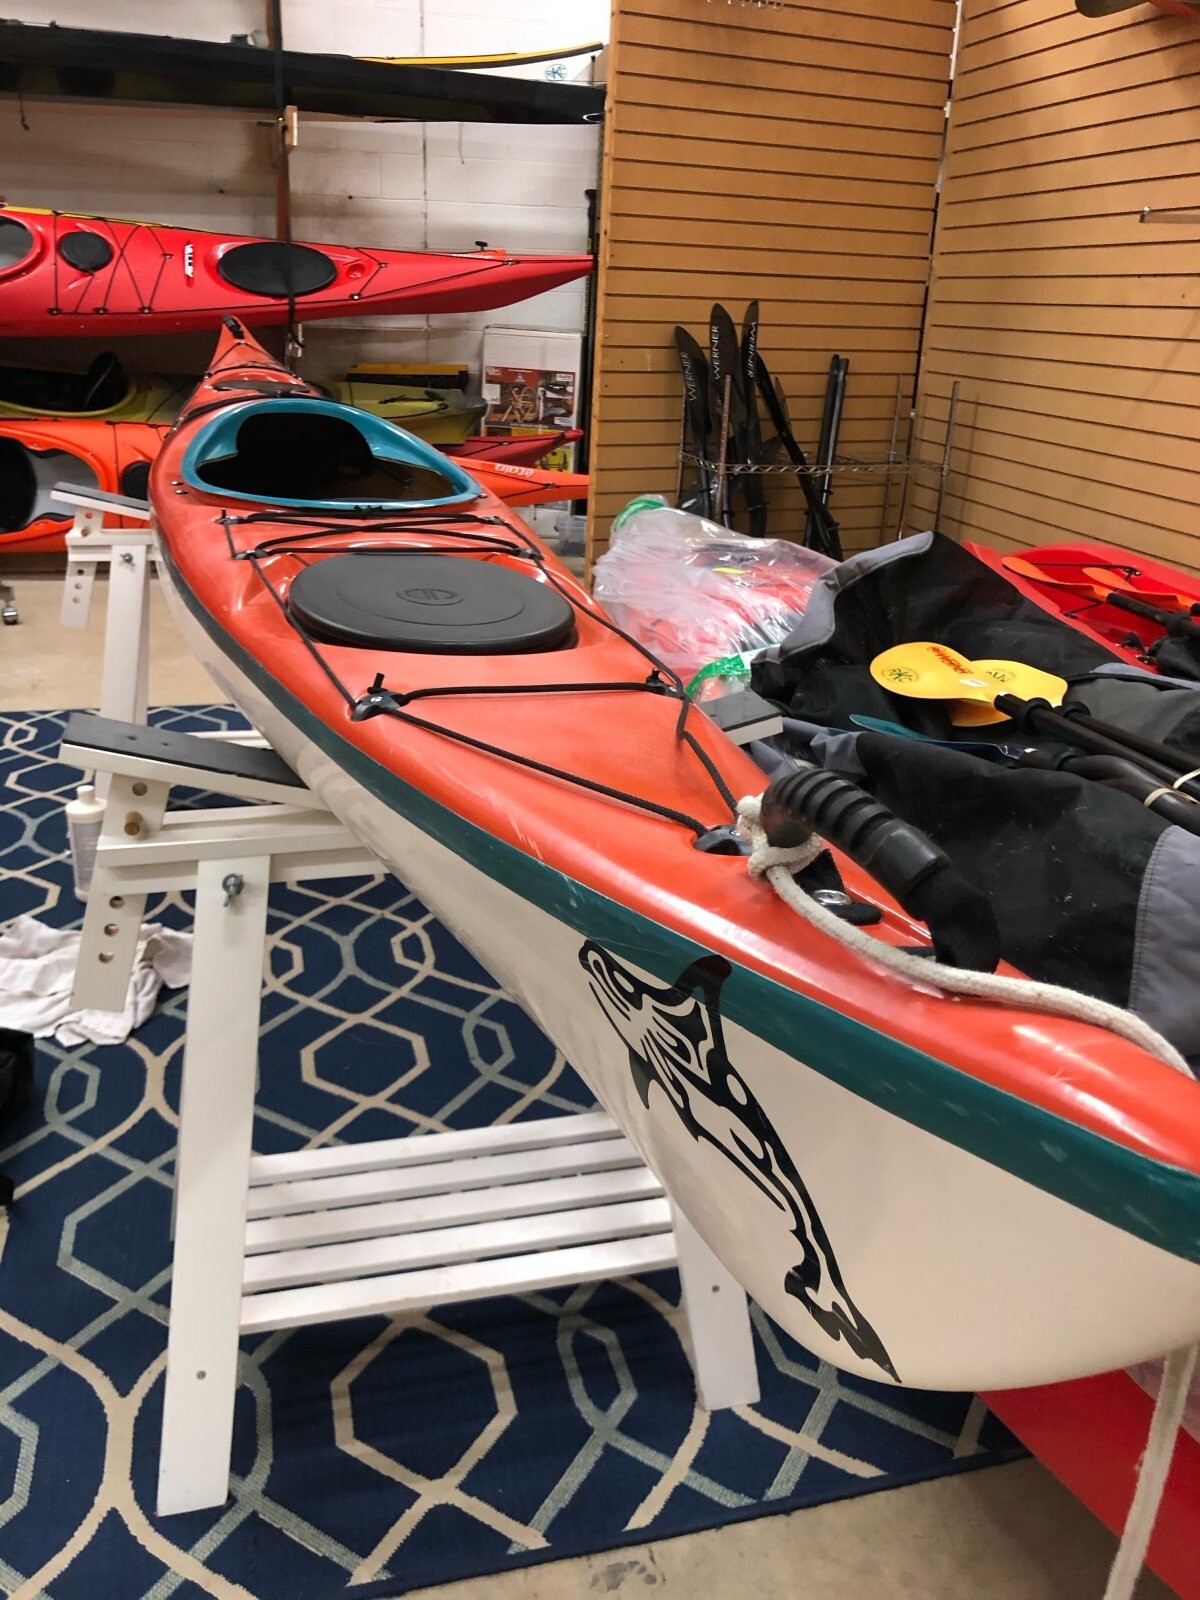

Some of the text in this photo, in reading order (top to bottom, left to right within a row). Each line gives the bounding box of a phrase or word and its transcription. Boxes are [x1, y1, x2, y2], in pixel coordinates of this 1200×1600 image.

[681, 351, 698, 400] WERNER
[711, 325, 719, 380] WERNER
[747, 321, 757, 378] WERNER
